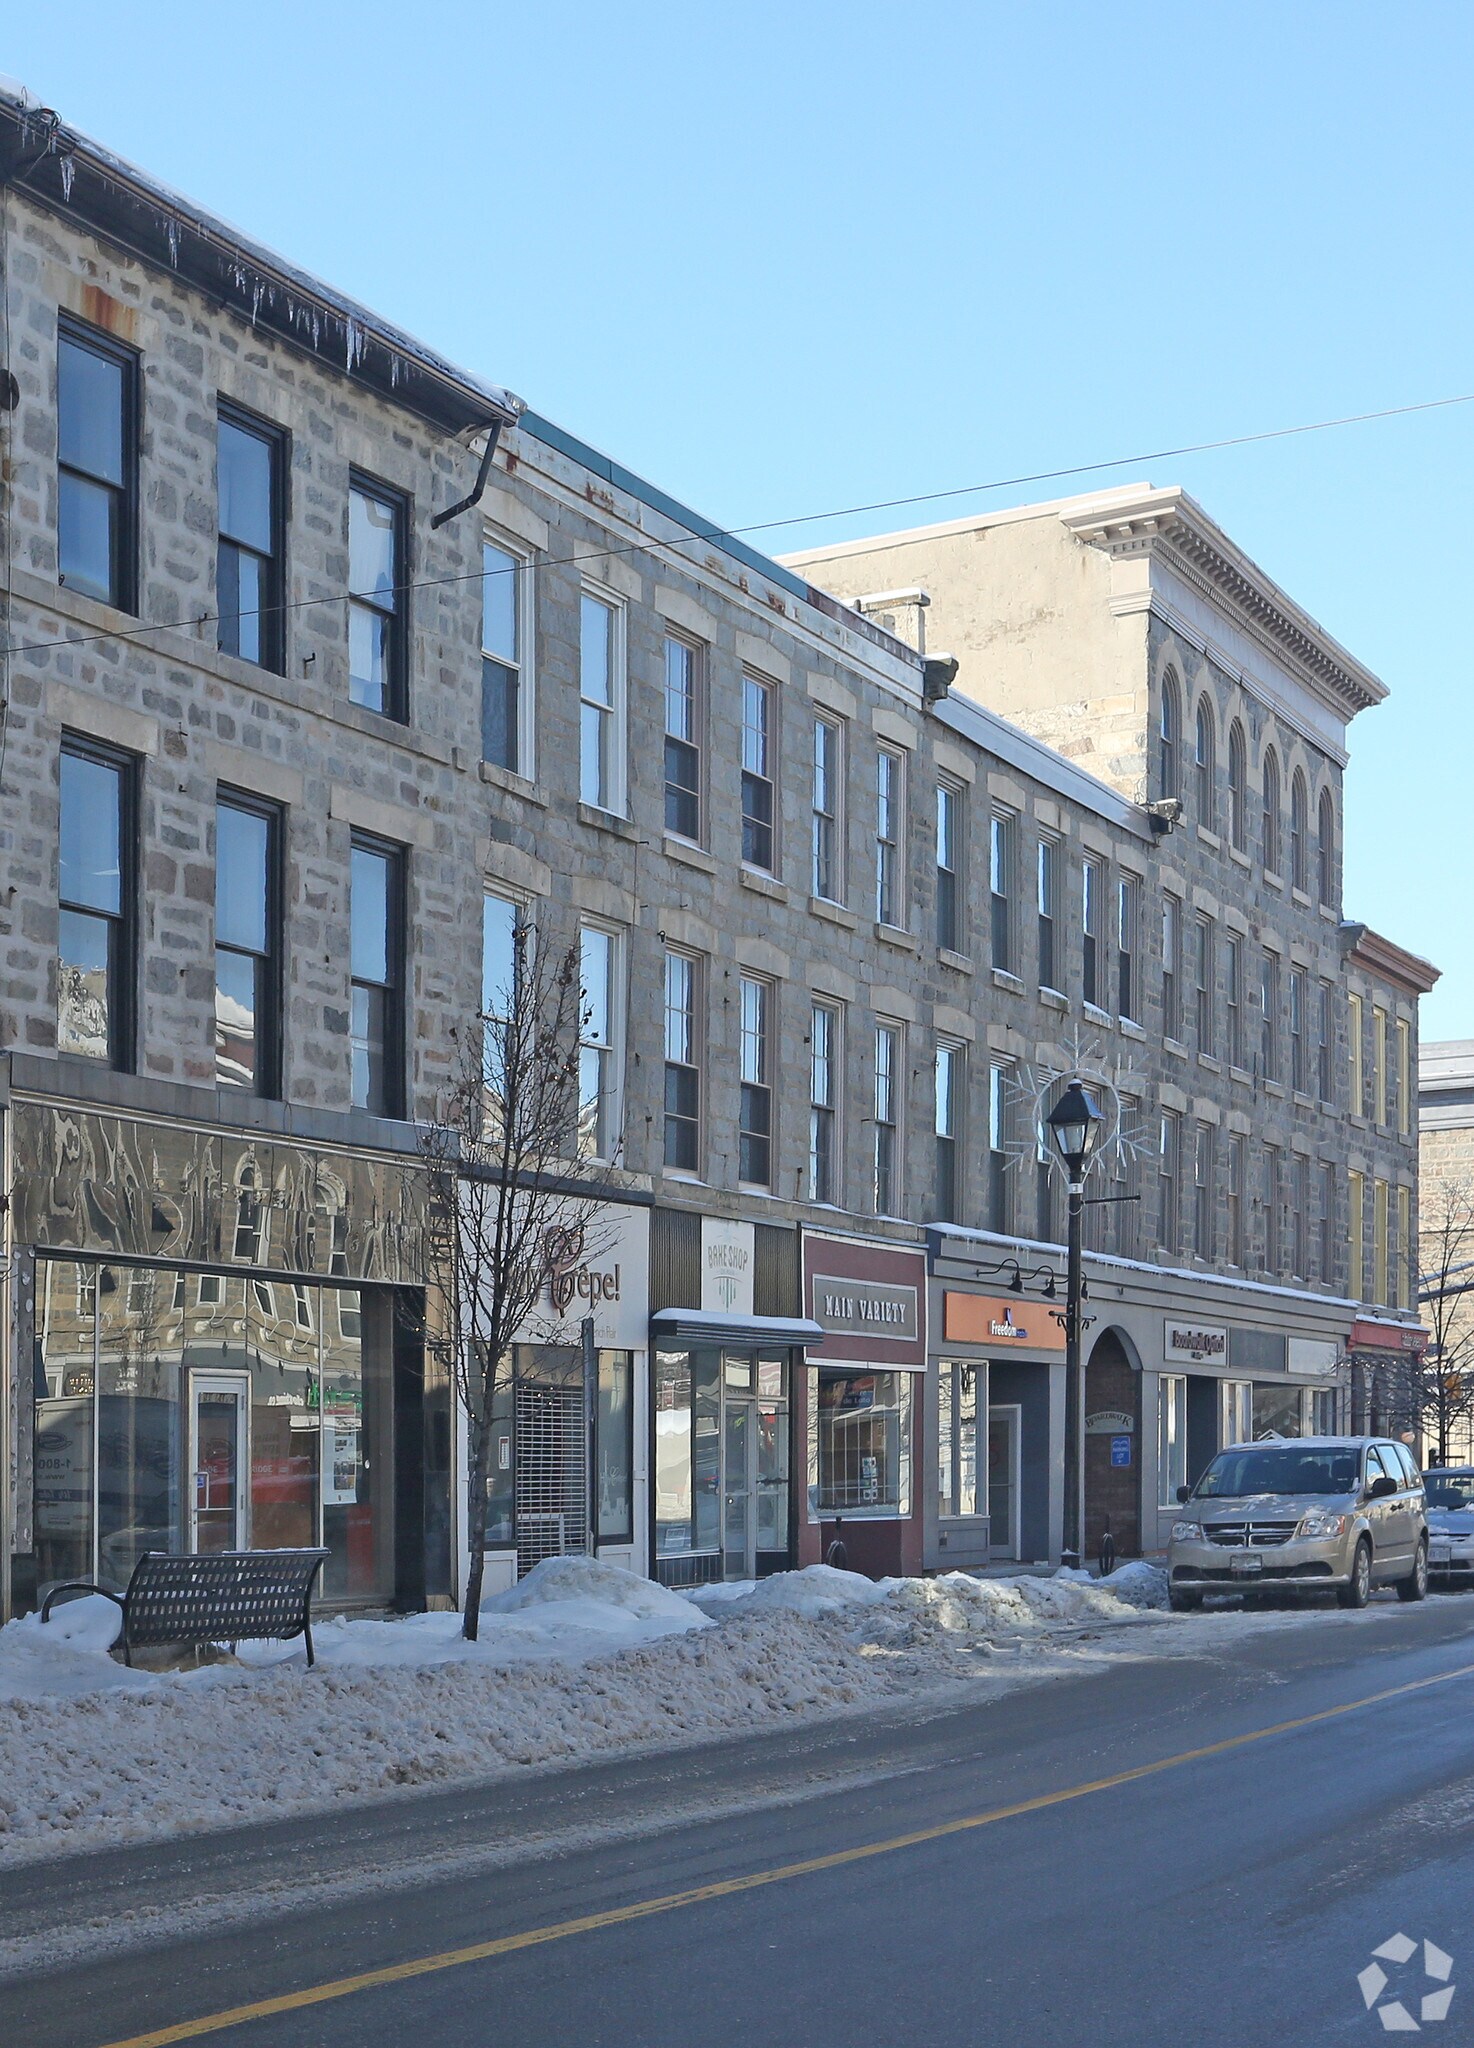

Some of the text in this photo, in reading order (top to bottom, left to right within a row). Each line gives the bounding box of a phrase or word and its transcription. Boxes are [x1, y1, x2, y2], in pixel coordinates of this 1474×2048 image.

[707, 1244, 748, 1271] BAKE SHOP
[825, 1295, 906, 1323] MAIN VARIETY
[989, 1320, 1017, 1338] Freedom
